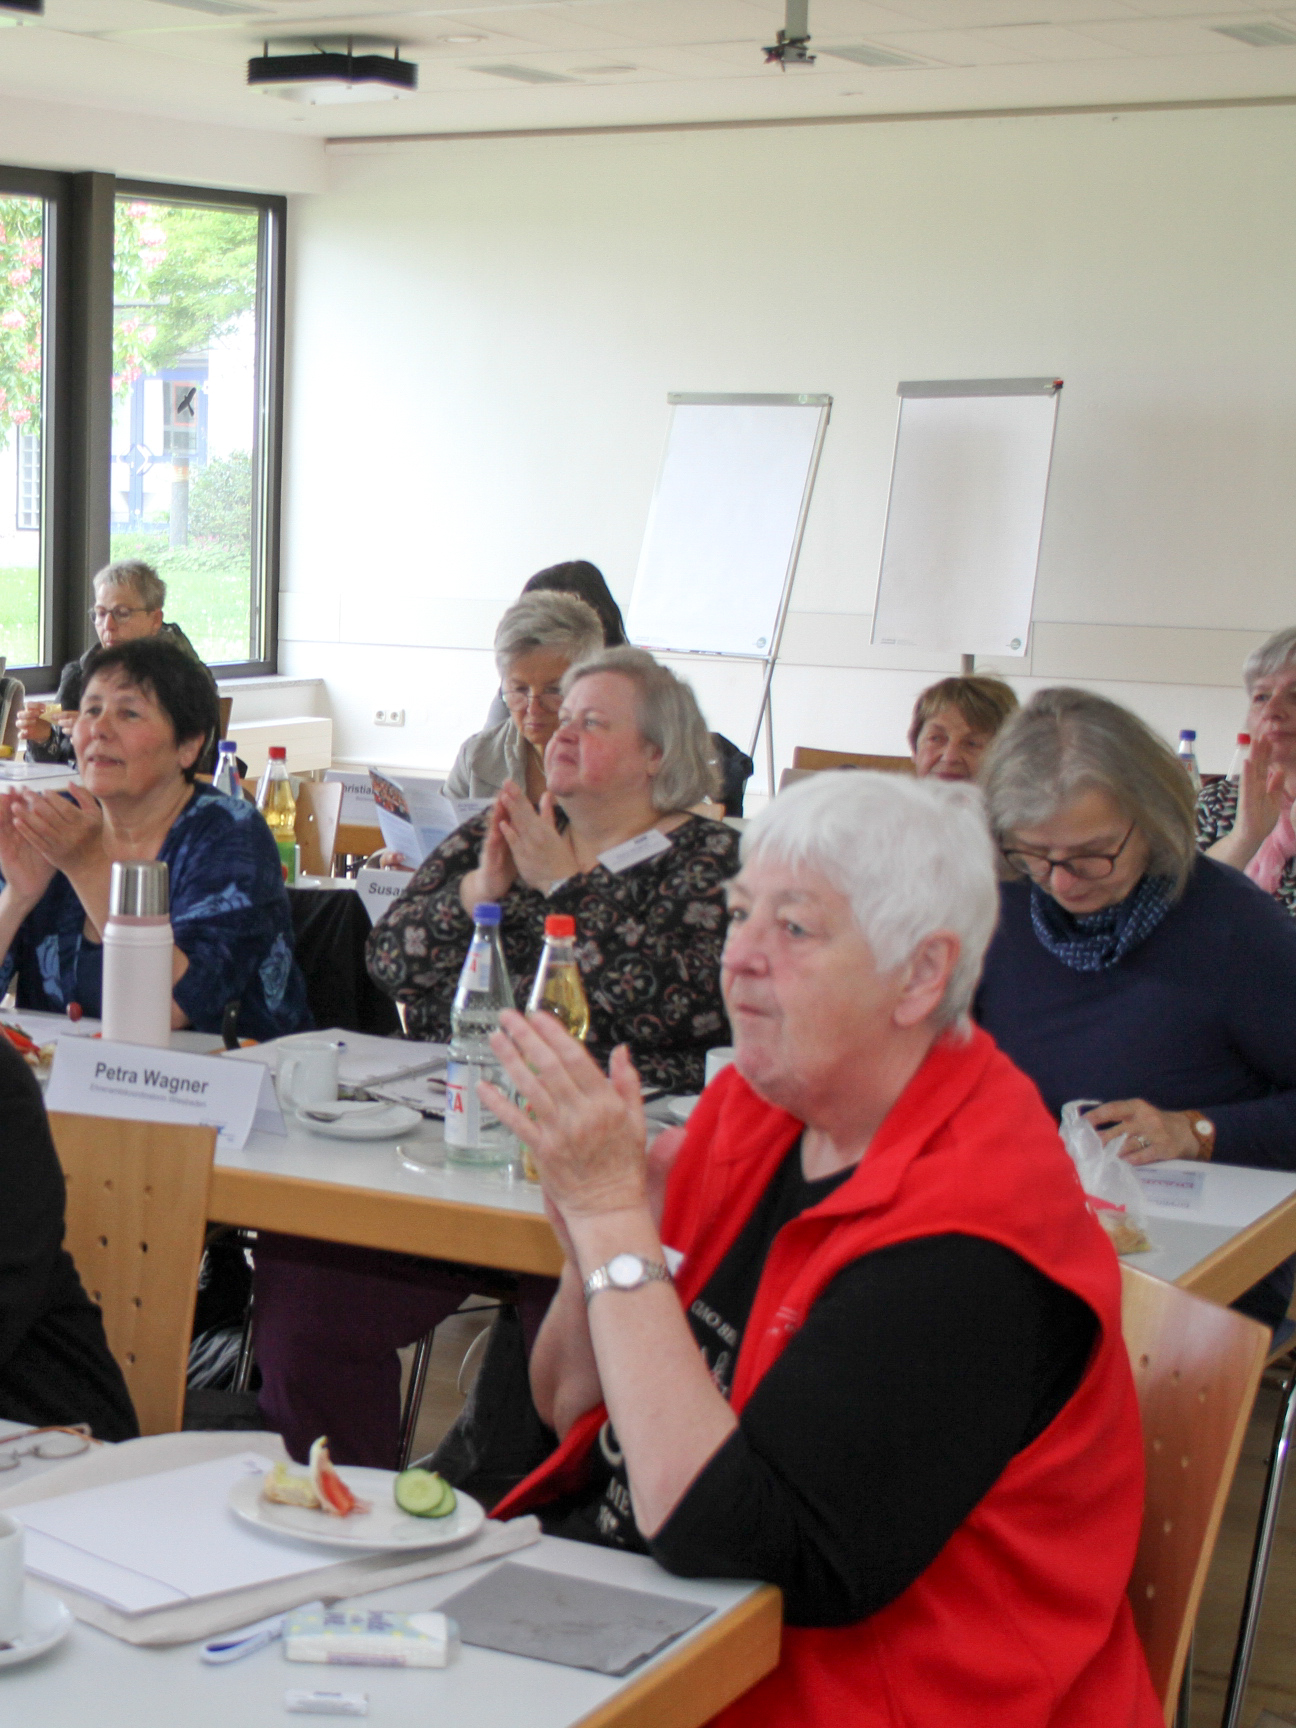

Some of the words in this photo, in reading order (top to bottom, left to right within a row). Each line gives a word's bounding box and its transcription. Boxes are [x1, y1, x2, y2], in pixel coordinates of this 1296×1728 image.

[343, 783, 374, 796] hristia
[95, 1061, 138, 1084] Petra
[143, 1069, 209, 1094] Wagner
